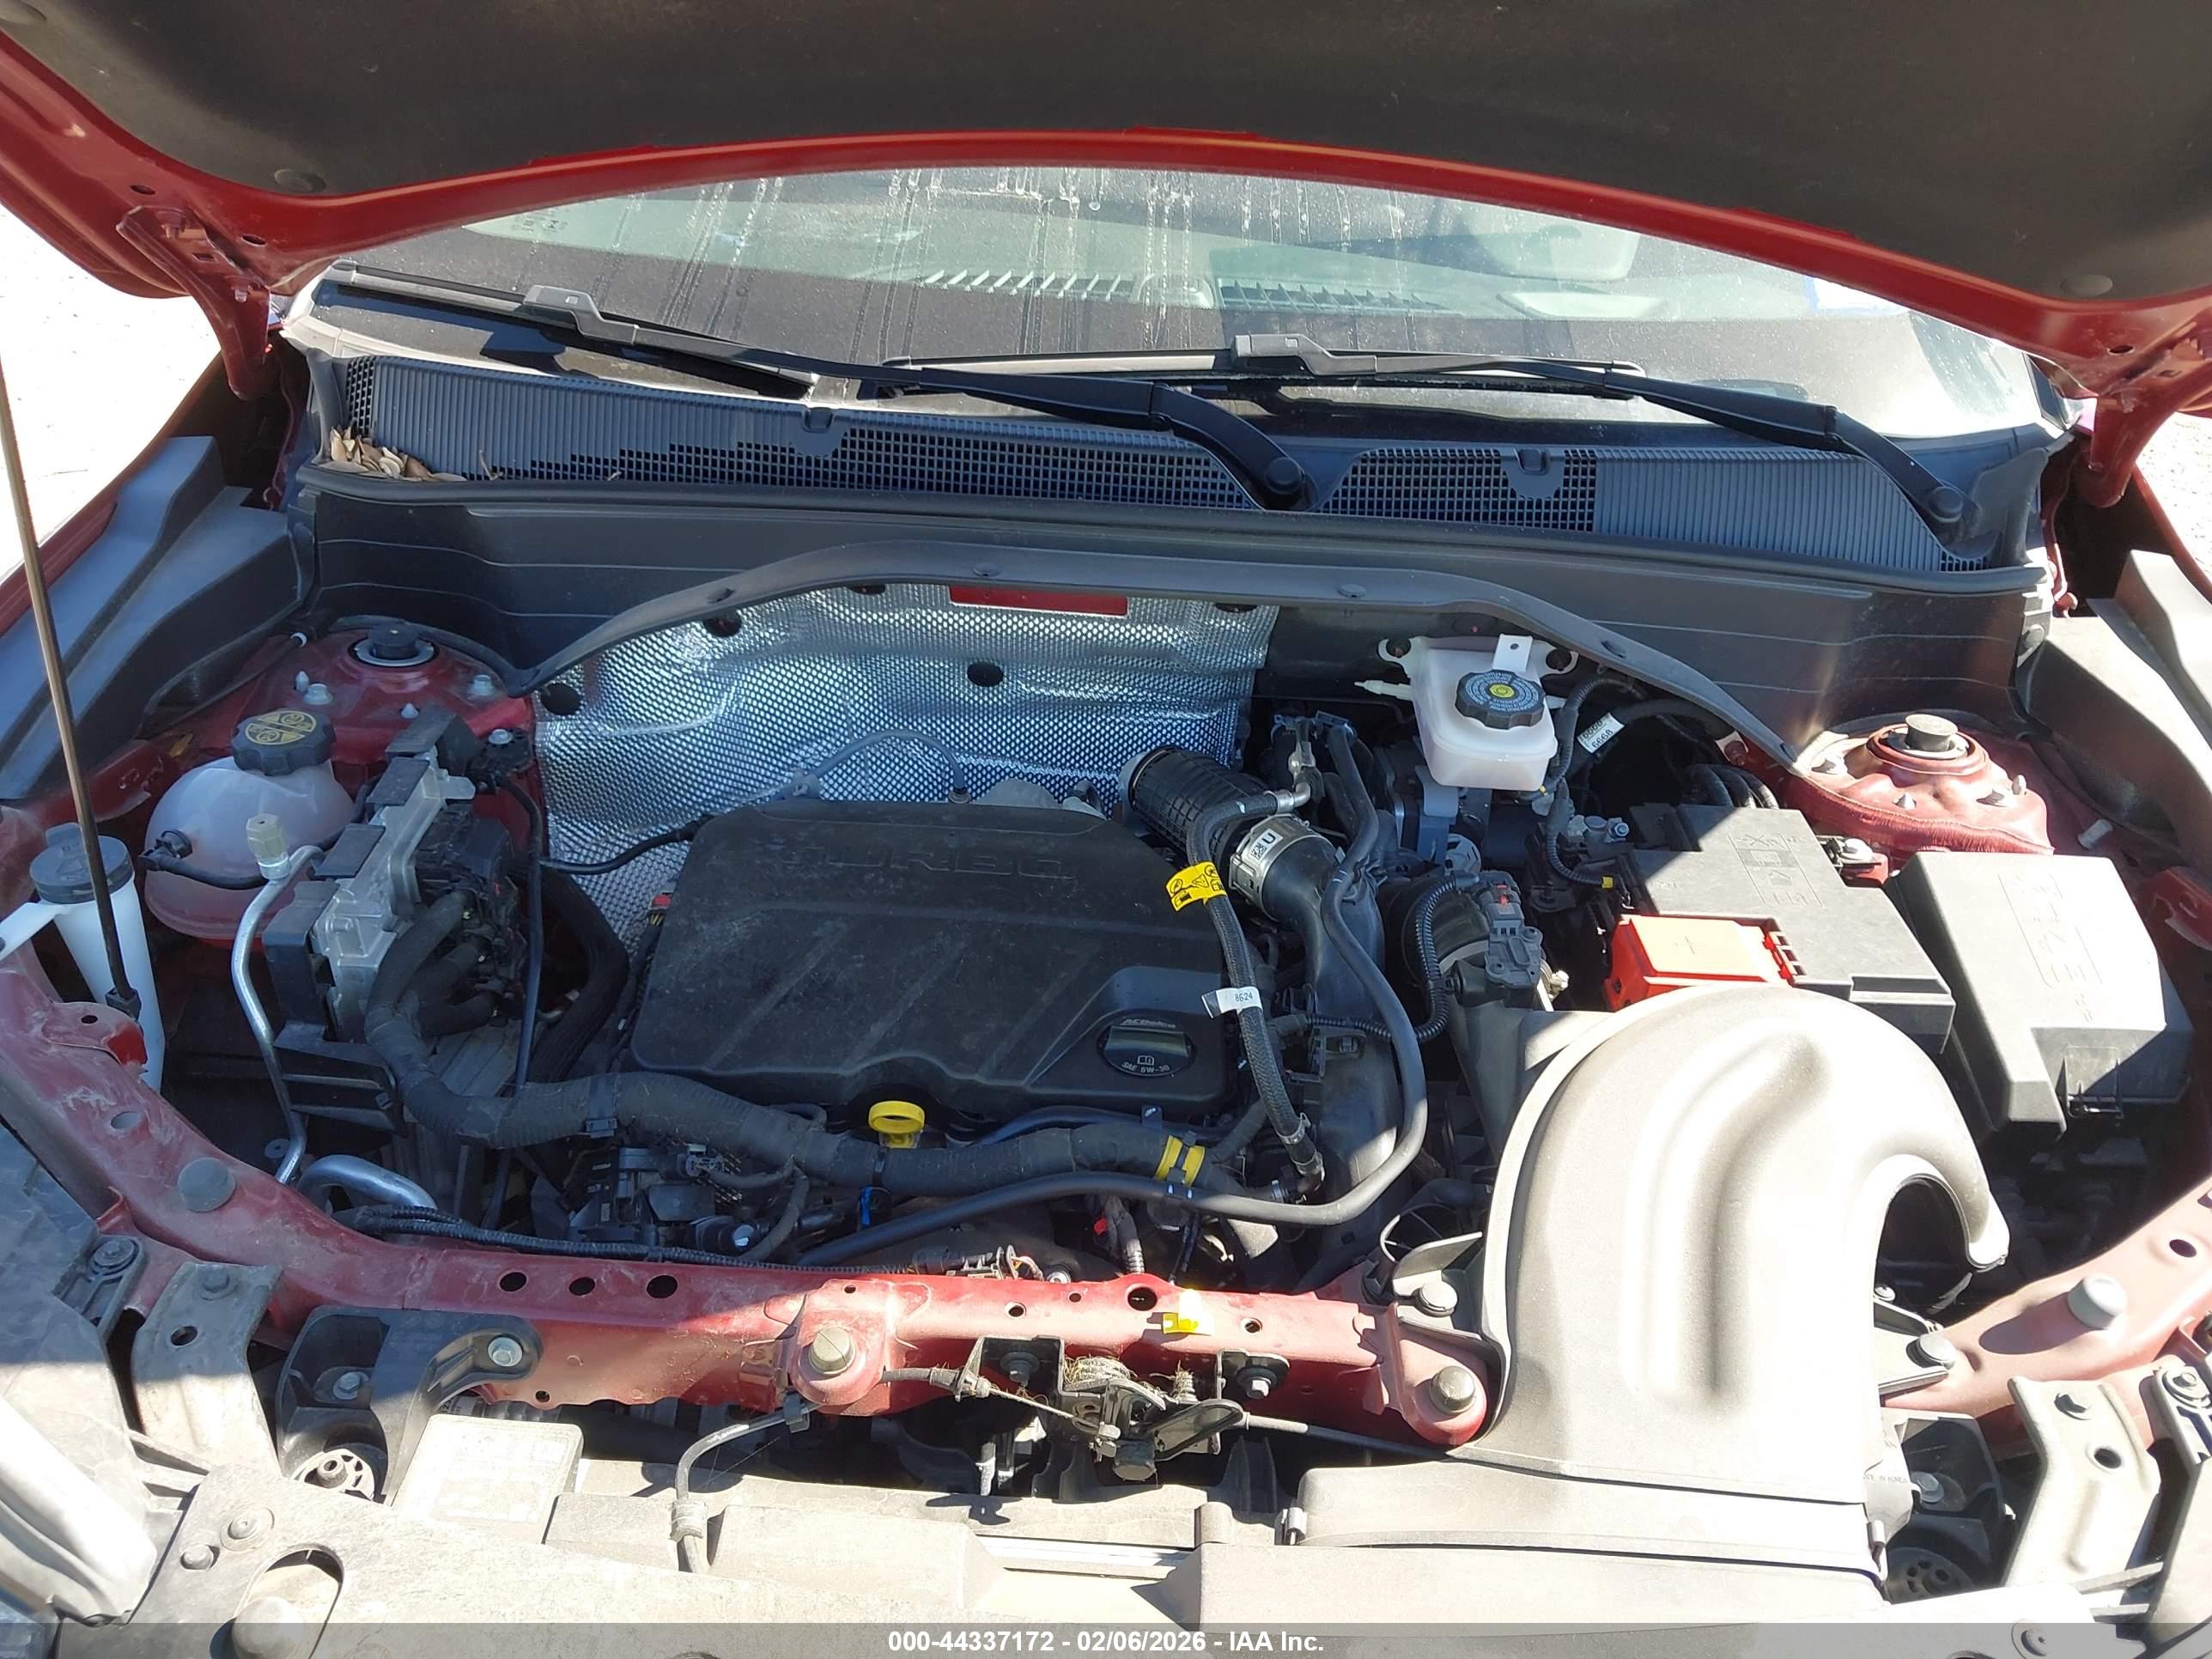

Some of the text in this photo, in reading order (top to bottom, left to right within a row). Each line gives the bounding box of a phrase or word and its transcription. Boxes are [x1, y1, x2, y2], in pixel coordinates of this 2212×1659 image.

[1591, 729, 1613, 748] 6668
[1261, 832, 1276, 844] U
[769, 845, 1077, 880] TURBO
[1235, 992, 1253, 1002] 8624
[1121, 1061, 1170, 1073] SAE 5W-30
